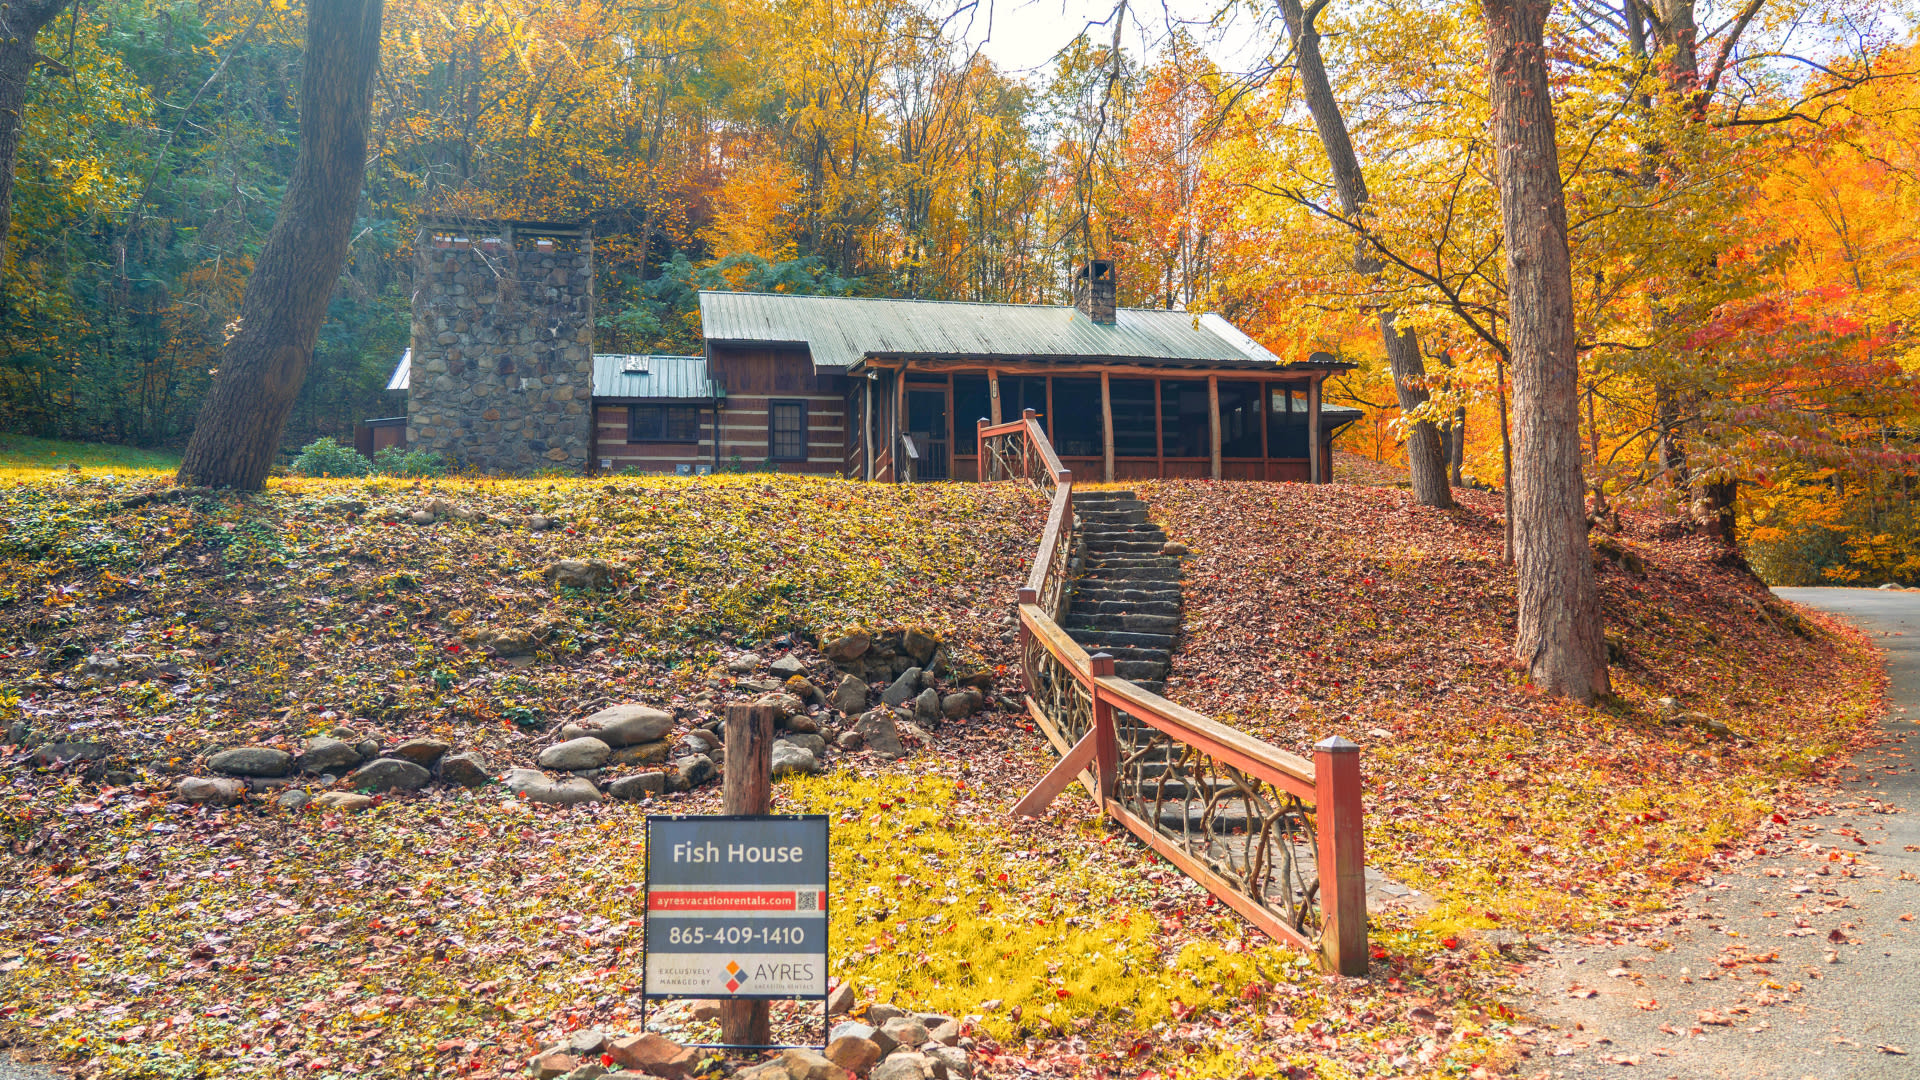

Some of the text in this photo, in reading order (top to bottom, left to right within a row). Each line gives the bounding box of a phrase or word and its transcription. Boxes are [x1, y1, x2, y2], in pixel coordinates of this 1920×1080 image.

[673, 841, 803, 863] Fish House
[657, 895, 792, 908] ayresvacationrentals.com
[669, 926, 805, 944] 865-409-1410
[754, 963, 814, 981] AYRES
